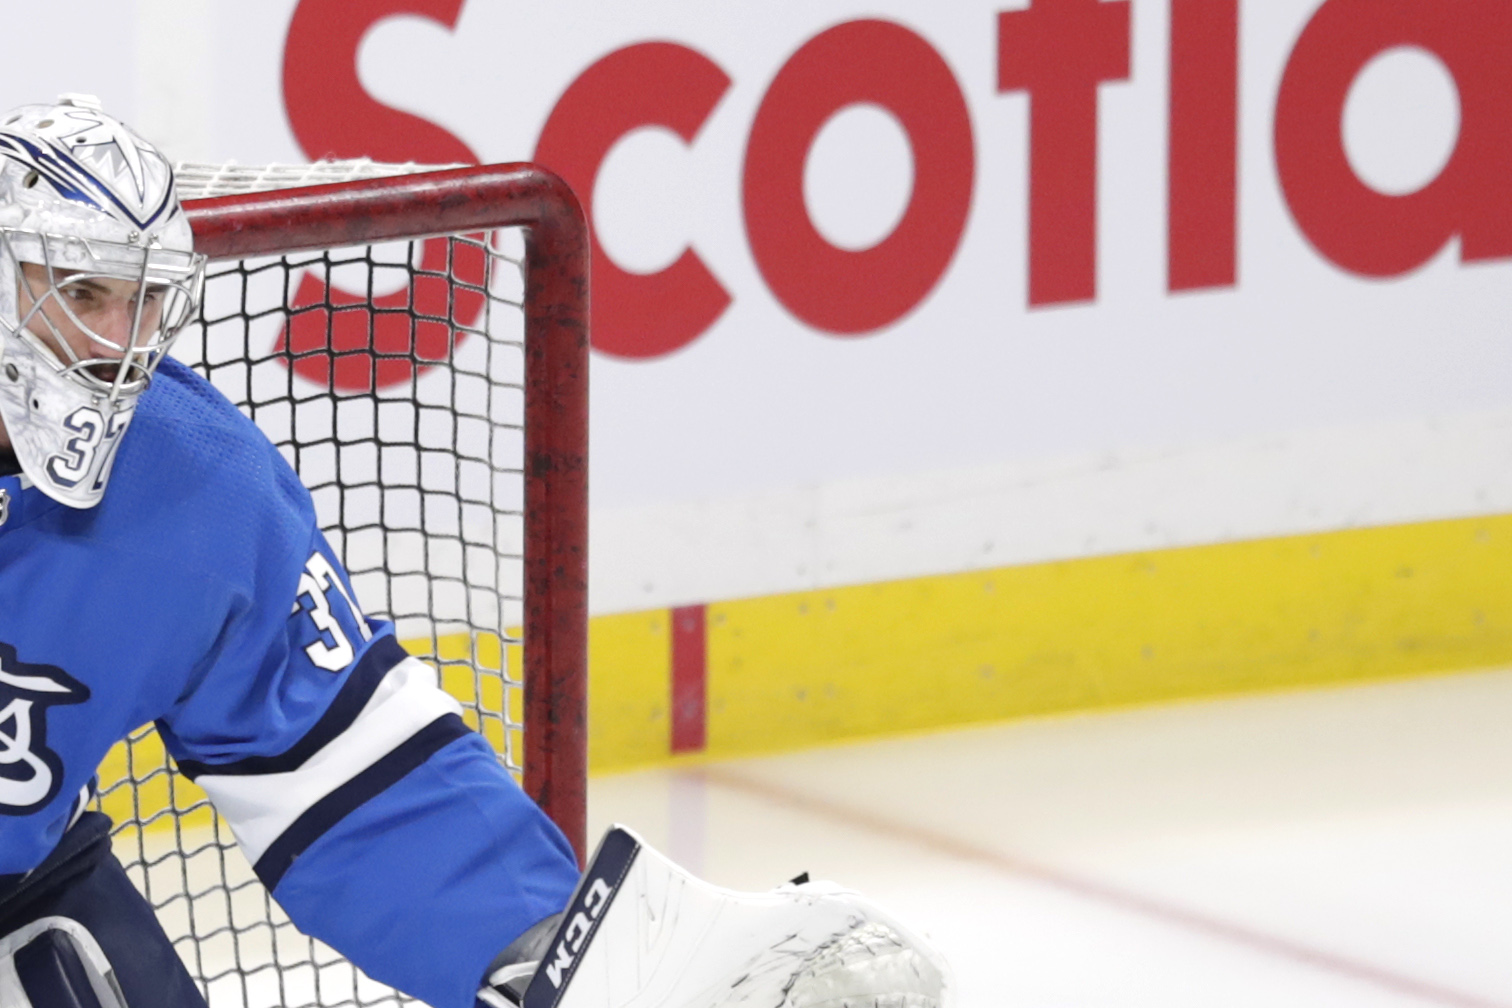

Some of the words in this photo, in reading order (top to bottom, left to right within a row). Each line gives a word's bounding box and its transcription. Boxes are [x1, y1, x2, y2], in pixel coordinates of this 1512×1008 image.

[272, 0, 1512, 392] Scotia
[45, 405, 135, 490] 37
[290, 551, 374, 672] 37
[544, 876, 613, 990] CCM
